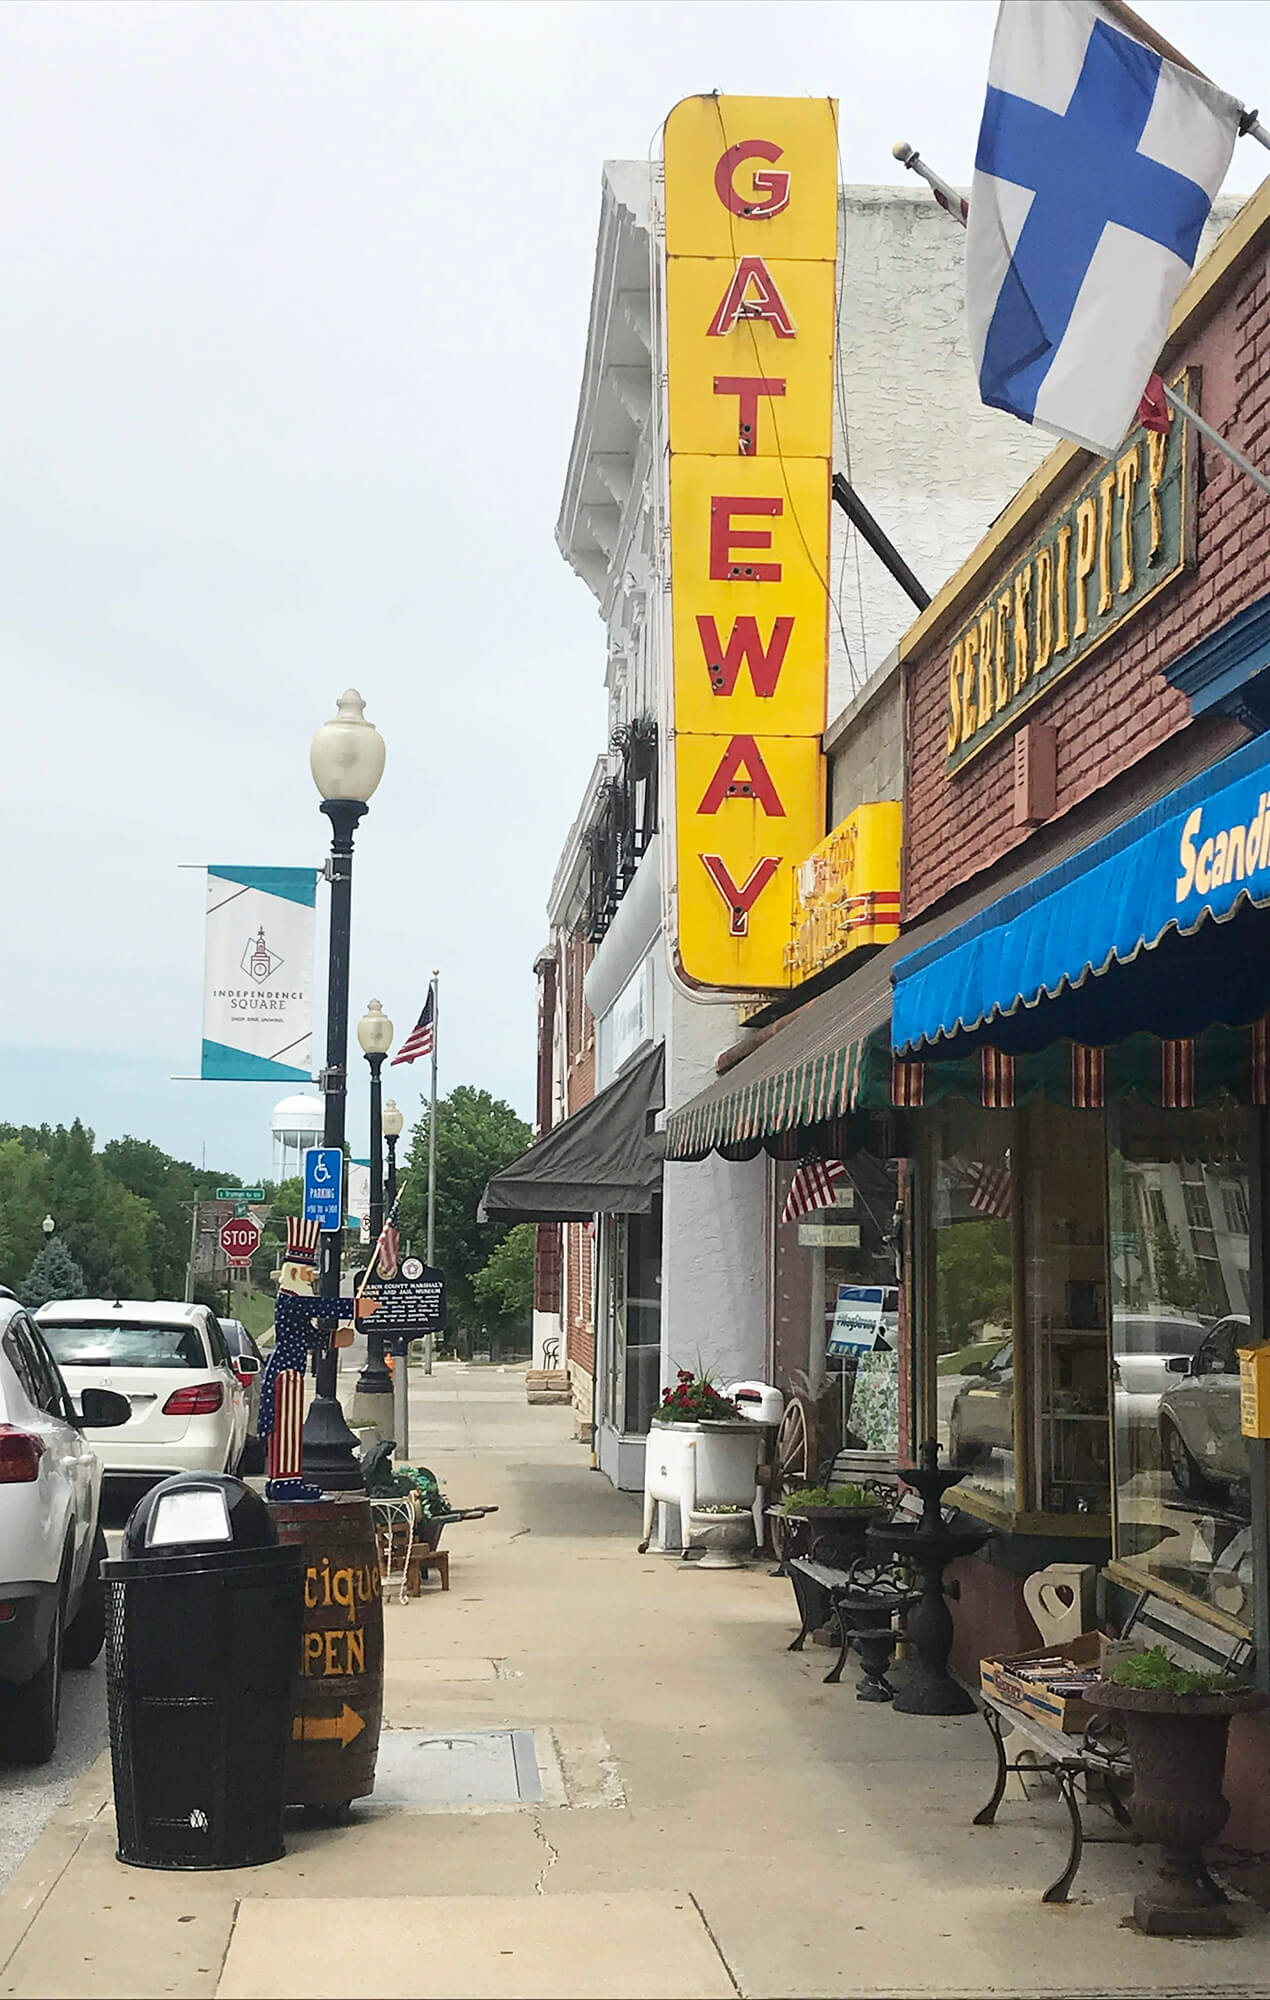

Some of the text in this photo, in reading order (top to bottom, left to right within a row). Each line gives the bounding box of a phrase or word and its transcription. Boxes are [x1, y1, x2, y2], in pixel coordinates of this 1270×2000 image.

[695, 138, 799, 938] GATEWAY
[947, 407, 1175, 755] SERENDIPITY
[1175, 786, 1270, 904] Scandi
[213, 990, 304, 1000] INDEPENDENCE
[230, 998, 287, 1010] SQUARE
[310, 1188, 335, 1199] PARKING
[223, 1231, 257, 1245] STOP
[301, 1628, 366, 1676] PEN
